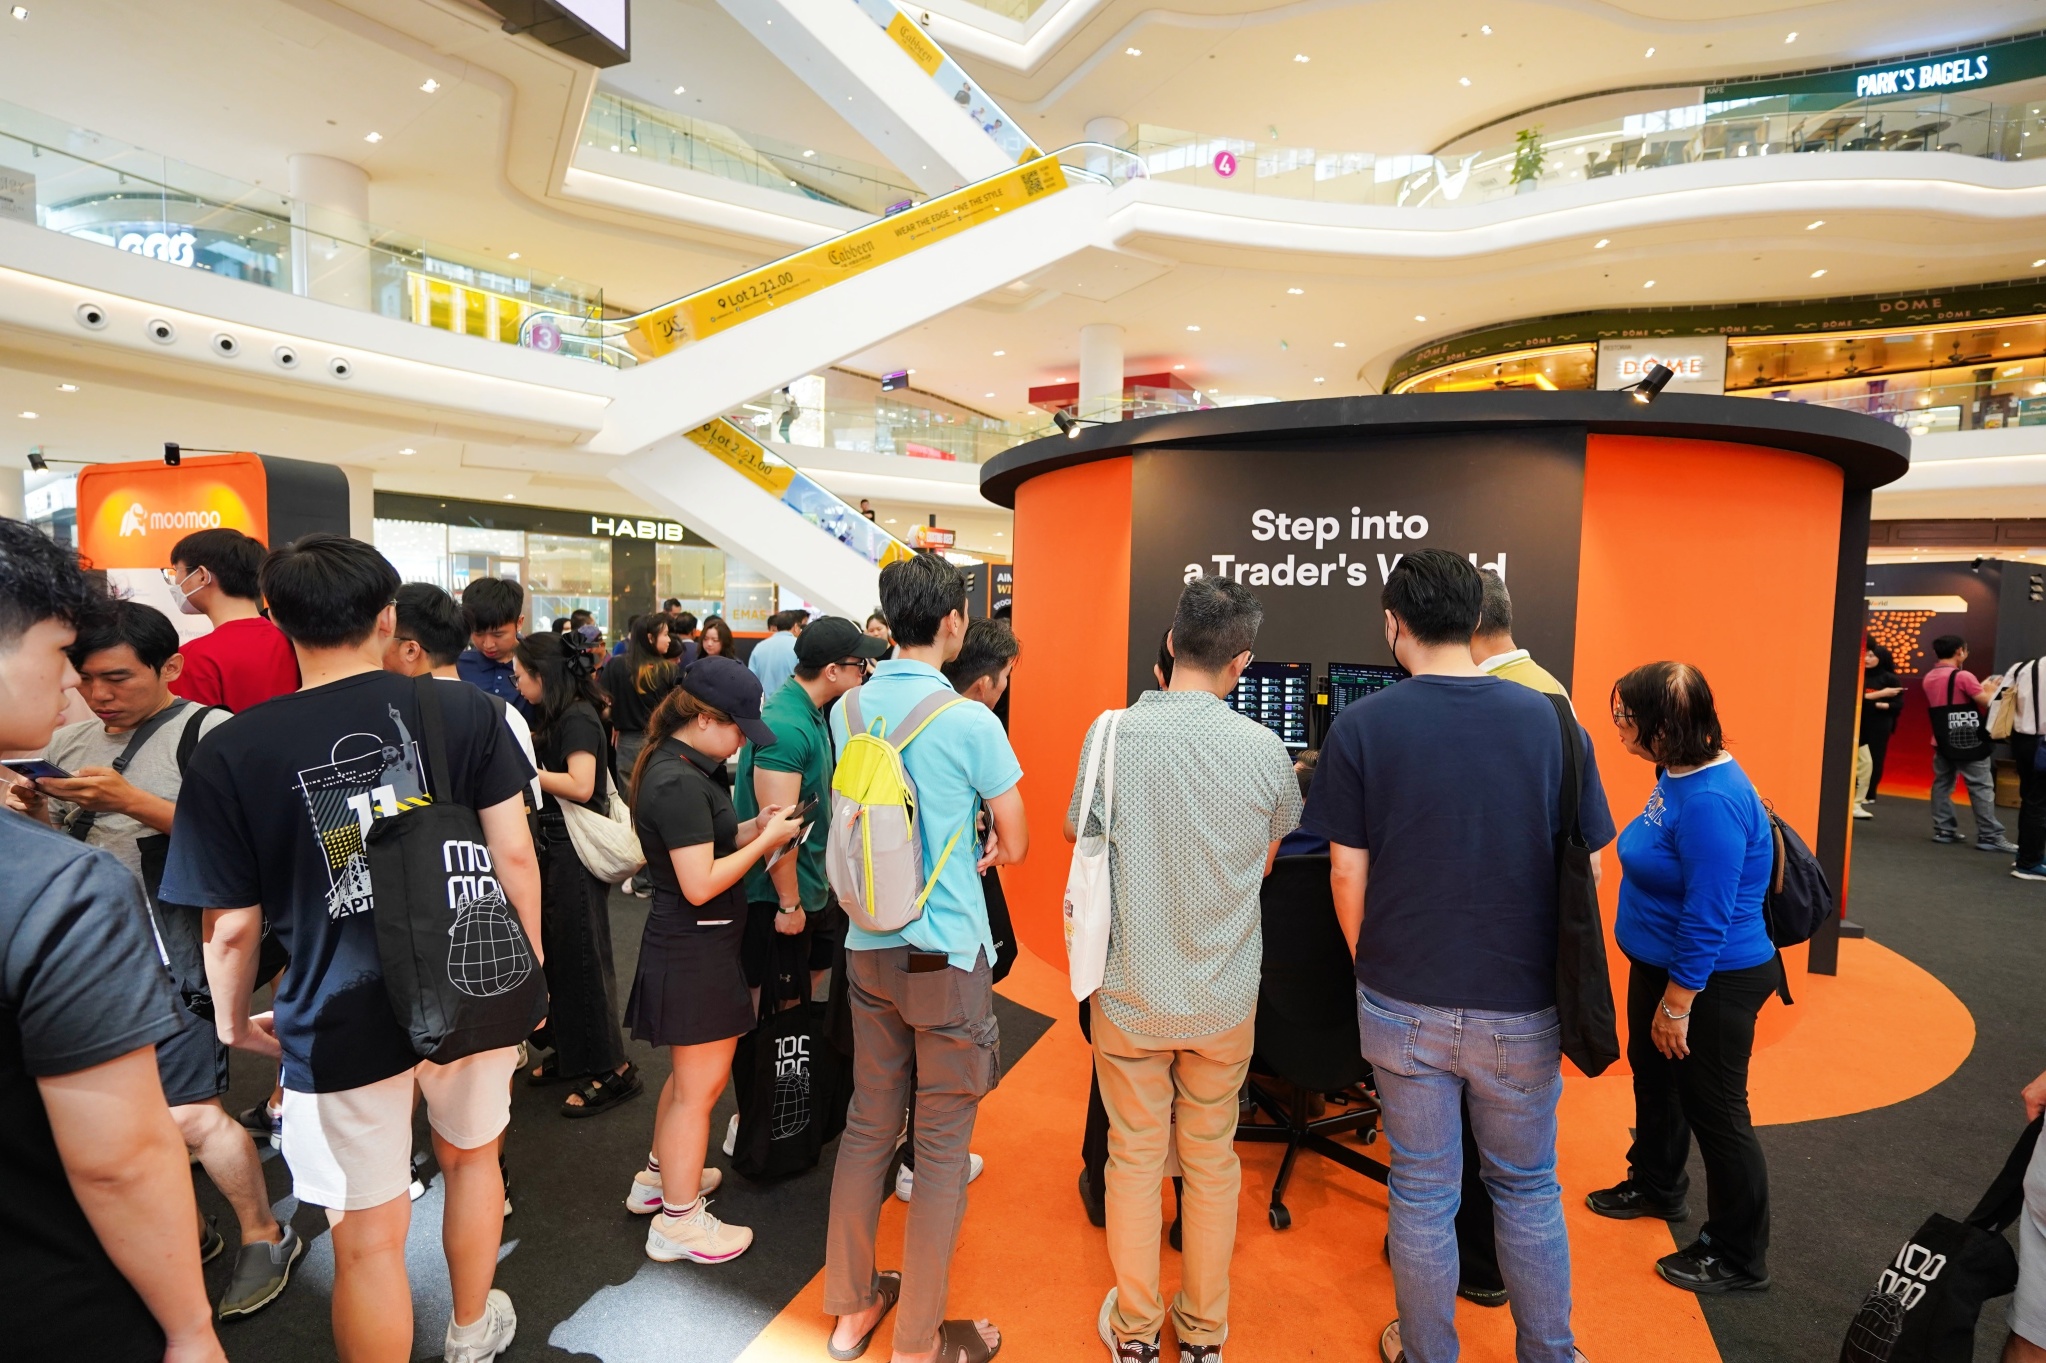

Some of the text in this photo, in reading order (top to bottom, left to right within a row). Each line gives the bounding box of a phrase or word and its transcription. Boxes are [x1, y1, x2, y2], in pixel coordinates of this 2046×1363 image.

[1857, 55, 1988, 97] PARK'S BAGELS
[1219, 155, 1231, 174] 4
[894, 220, 916, 237] WEAR
[916, 216, 930, 228] THE
[969, 197, 983, 208] THE
[982, 188, 1004, 202] STYLE
[828, 241, 875, 265] Cabbeen
[727, 290, 750, 306] Lot
[749, 272, 794, 297] 2.21.00
[538, 329, 552, 349] 3
[711, 429, 730, 447] Lot
[731, 443, 772, 475] 2.21.00
[150, 510, 221, 530] moomoo
[592, 516, 683, 542] HABIB
[1251, 506, 1429, 549] Step into
[1183, 562, 1205, 585] a
[1211, 553, 1367, 587] Trader's
[733, 609, 767, 620] EMAS
